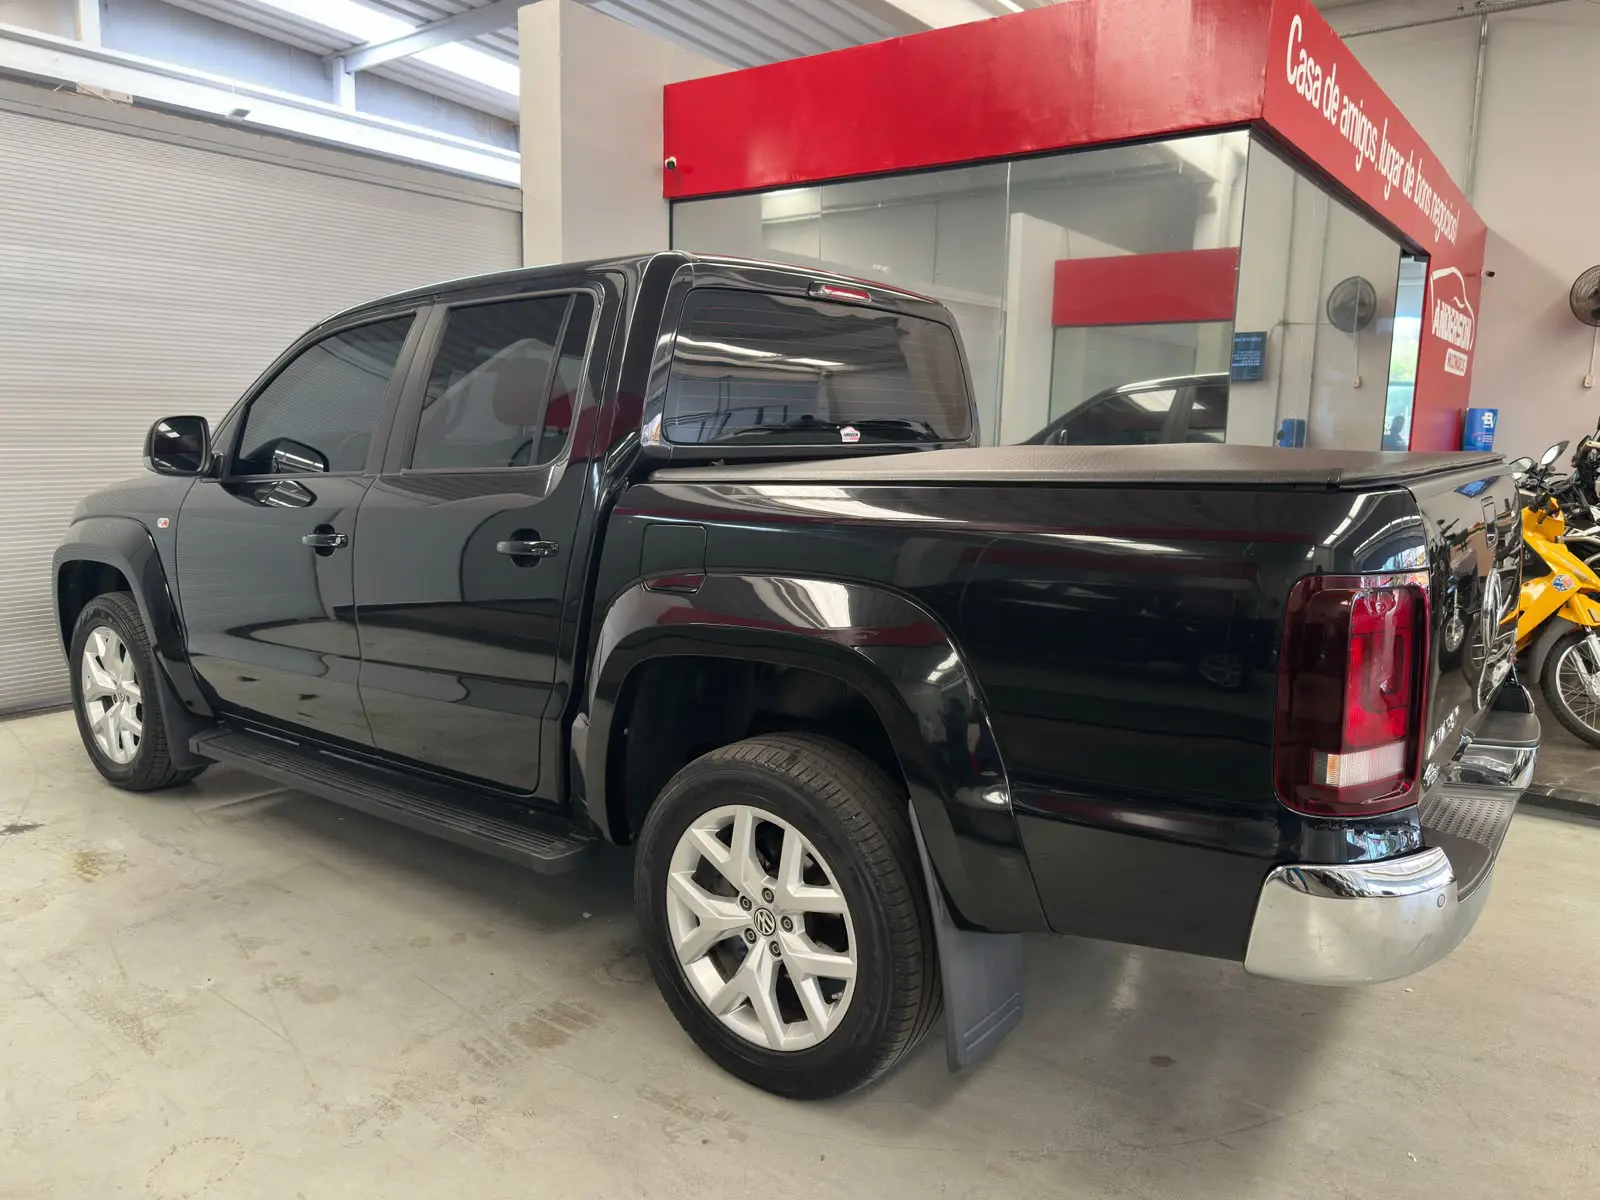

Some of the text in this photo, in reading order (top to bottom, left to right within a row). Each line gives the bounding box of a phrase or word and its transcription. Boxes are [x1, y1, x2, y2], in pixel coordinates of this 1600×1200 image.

[1286, 14, 1322, 110] Casa
[1322, 62, 1340, 126] de
[1402, 149, 1415, 200] de
[1414, 158, 1432, 217] bons
